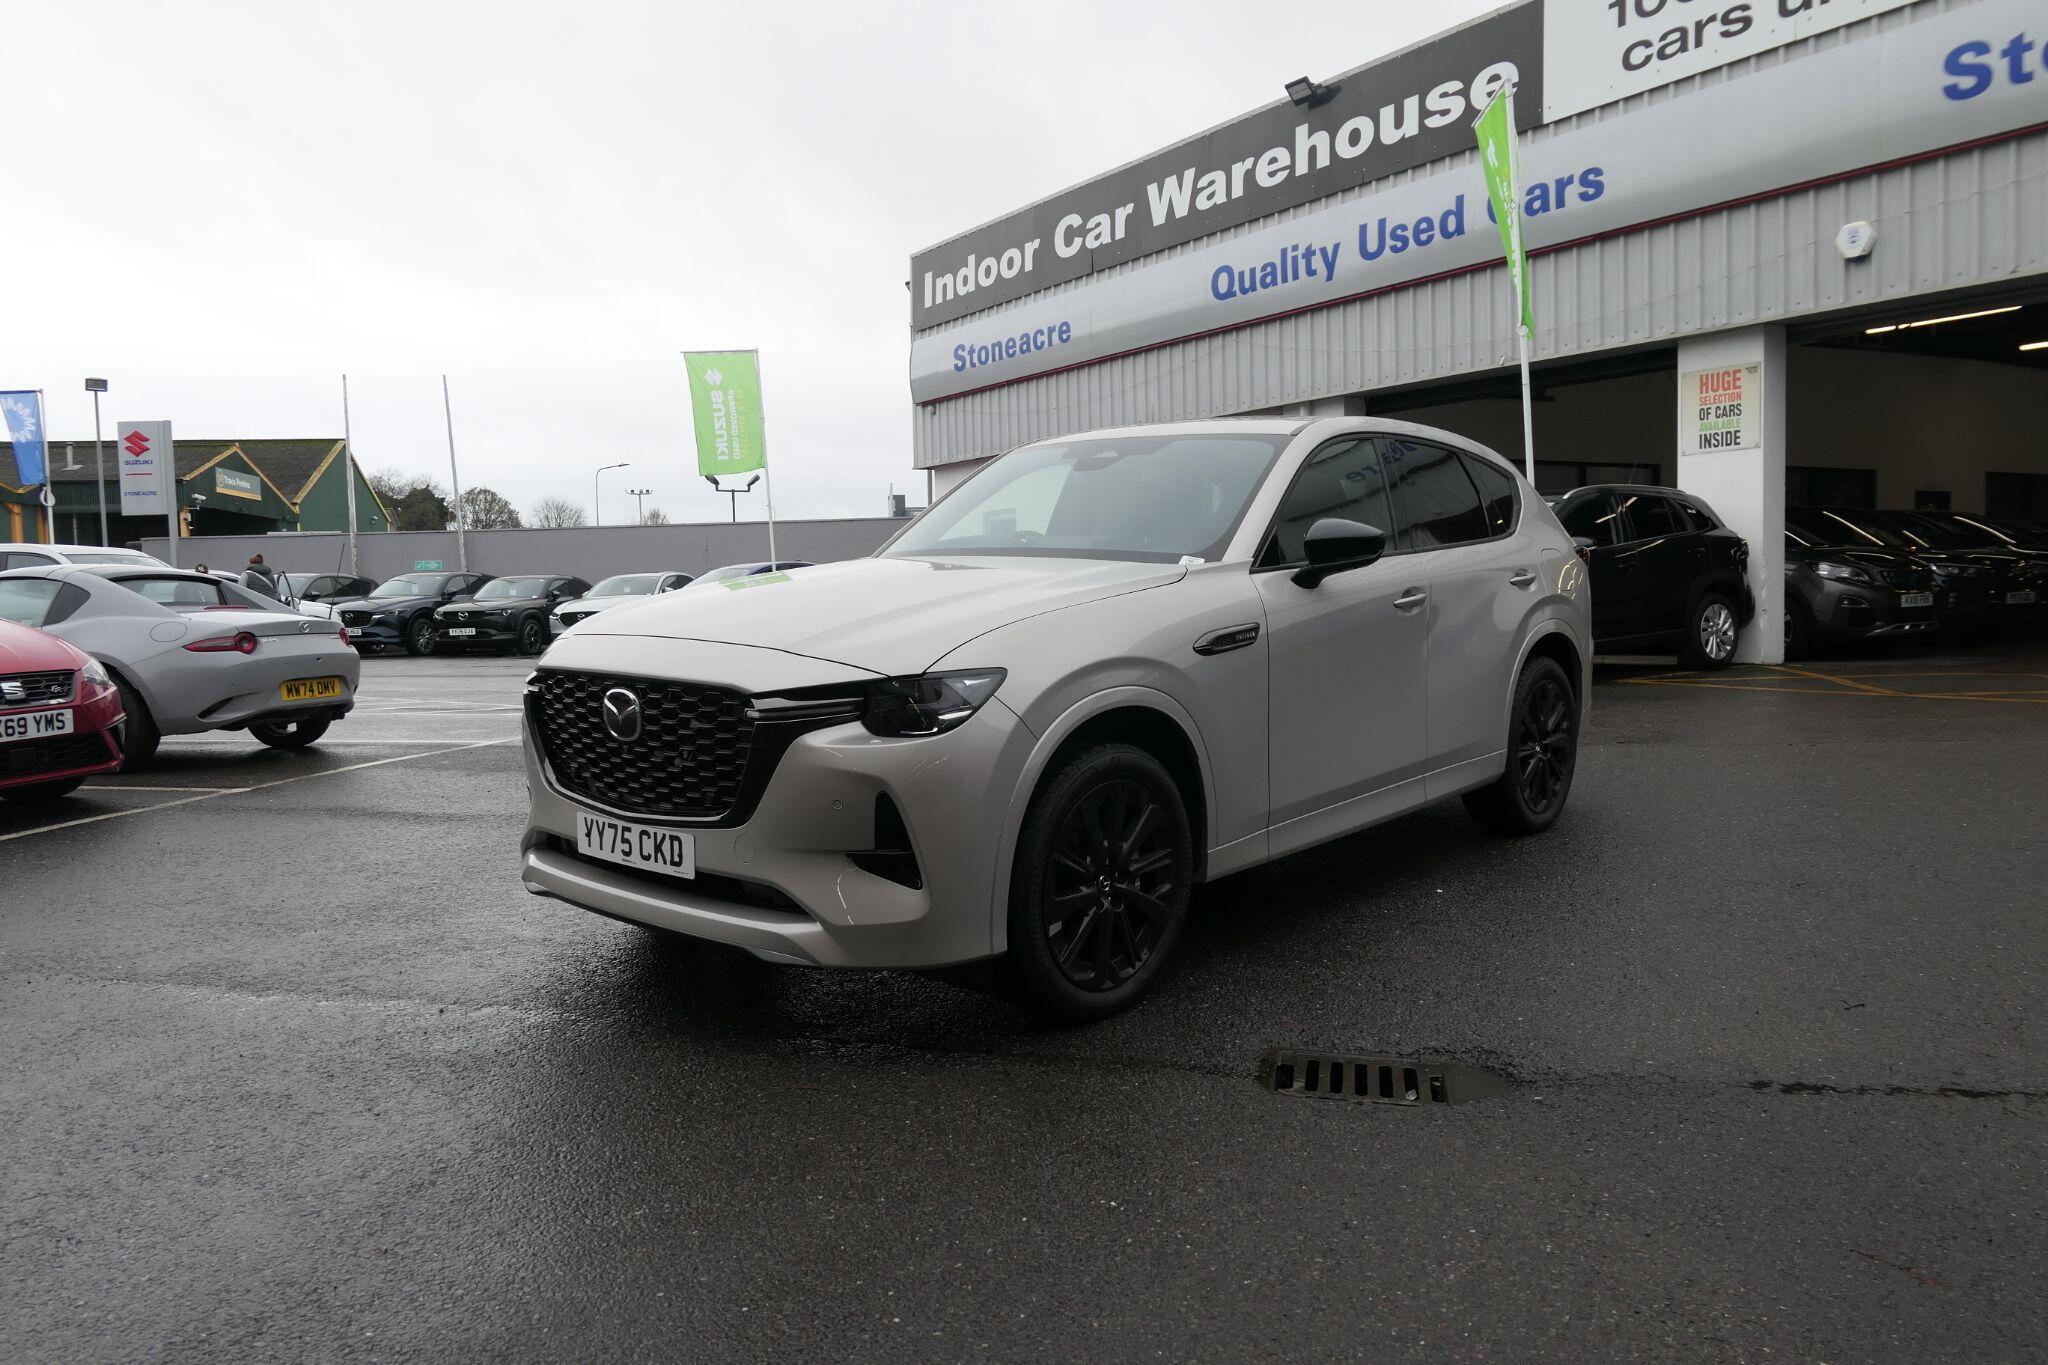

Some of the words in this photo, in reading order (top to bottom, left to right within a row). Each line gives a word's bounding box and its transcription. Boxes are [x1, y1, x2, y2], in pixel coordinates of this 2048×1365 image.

[1622, 3, 1753, 71] cars
[1943, 31, 2048, 101] St
[924, 238, 1041, 309] Indoor
[1054, 202, 1135, 258] Car
[1147, 62, 1519, 227] Warehouse
[1211, 241, 1341, 301] Quality
[1358, 193, 1466, 262] Used
[1487, 166, 1605, 225] ars
[953, 320, 1072, 373] Stoneacre
[1699, 369, 1742, 394] HUGE
[1698, 391, 1743, 407] SELECTION
[1699, 406, 1712, 421] OF
[1714, 403, 1743, 419] CARS
[1698, 419, 1741, 432] AVAILABLE
[1699, 429, 1742, 450] INSIDE
[223, 475, 236, 486] Travis
[286, 681, 315, 699] MW74
[0, 716, 28, 738] 69
[33, 712, 66, 734] YMS
[584, 816, 633, 858] YY75
[638, 829, 683, 868] CKD
